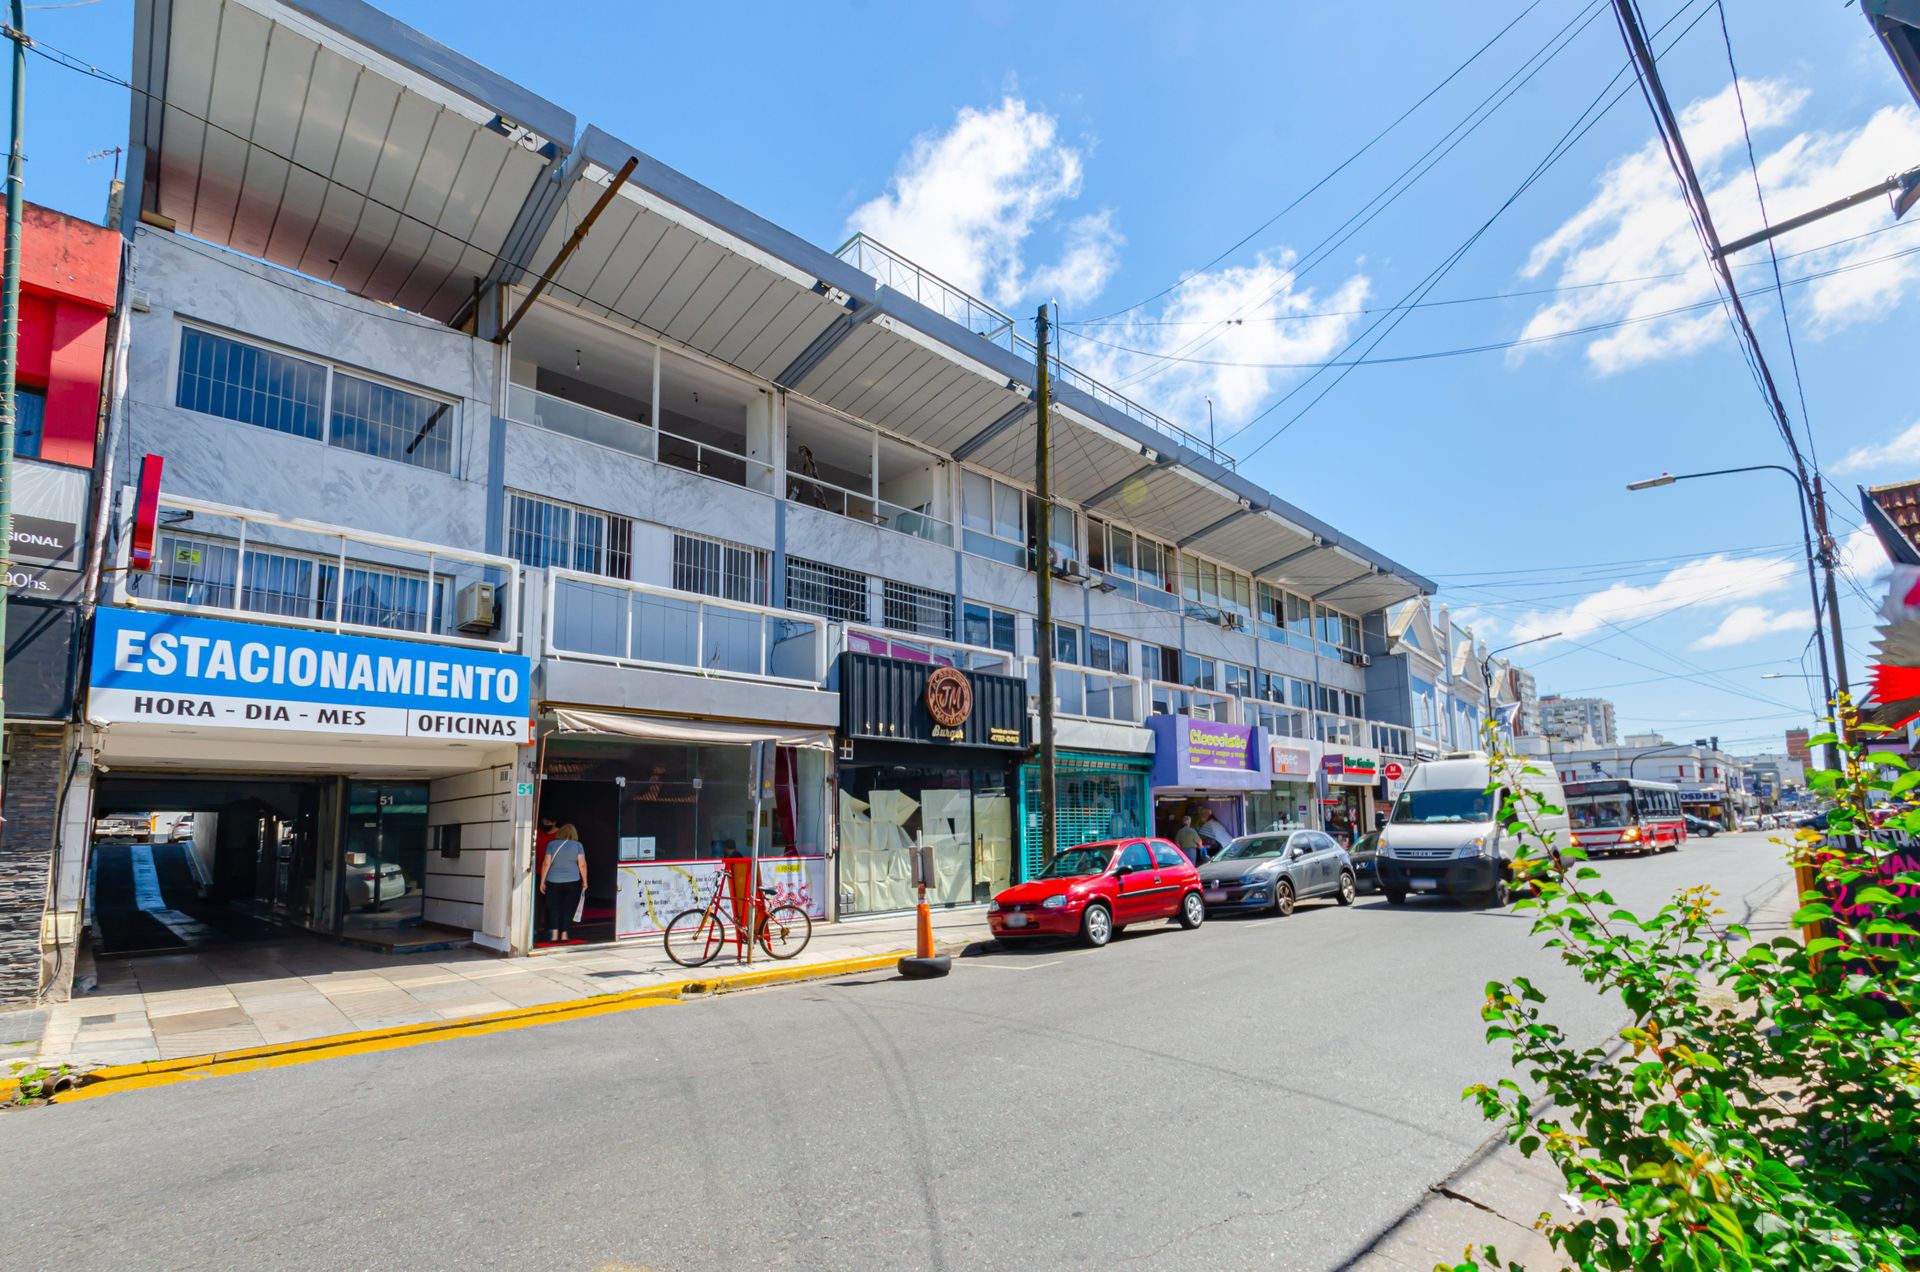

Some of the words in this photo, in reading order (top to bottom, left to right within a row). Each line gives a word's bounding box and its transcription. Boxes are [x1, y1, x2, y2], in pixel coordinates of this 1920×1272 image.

[114, 628, 519, 703] ESTACIONAMIENTO
[134, 696, 215, 718] HORA
[245, 703, 290, 722] DIA
[317, 708, 366, 726] MES
[418, 714, 517, 736] OFICINAS
[518, 783, 533, 795] 51
[380, 796, 393, 805] 51
